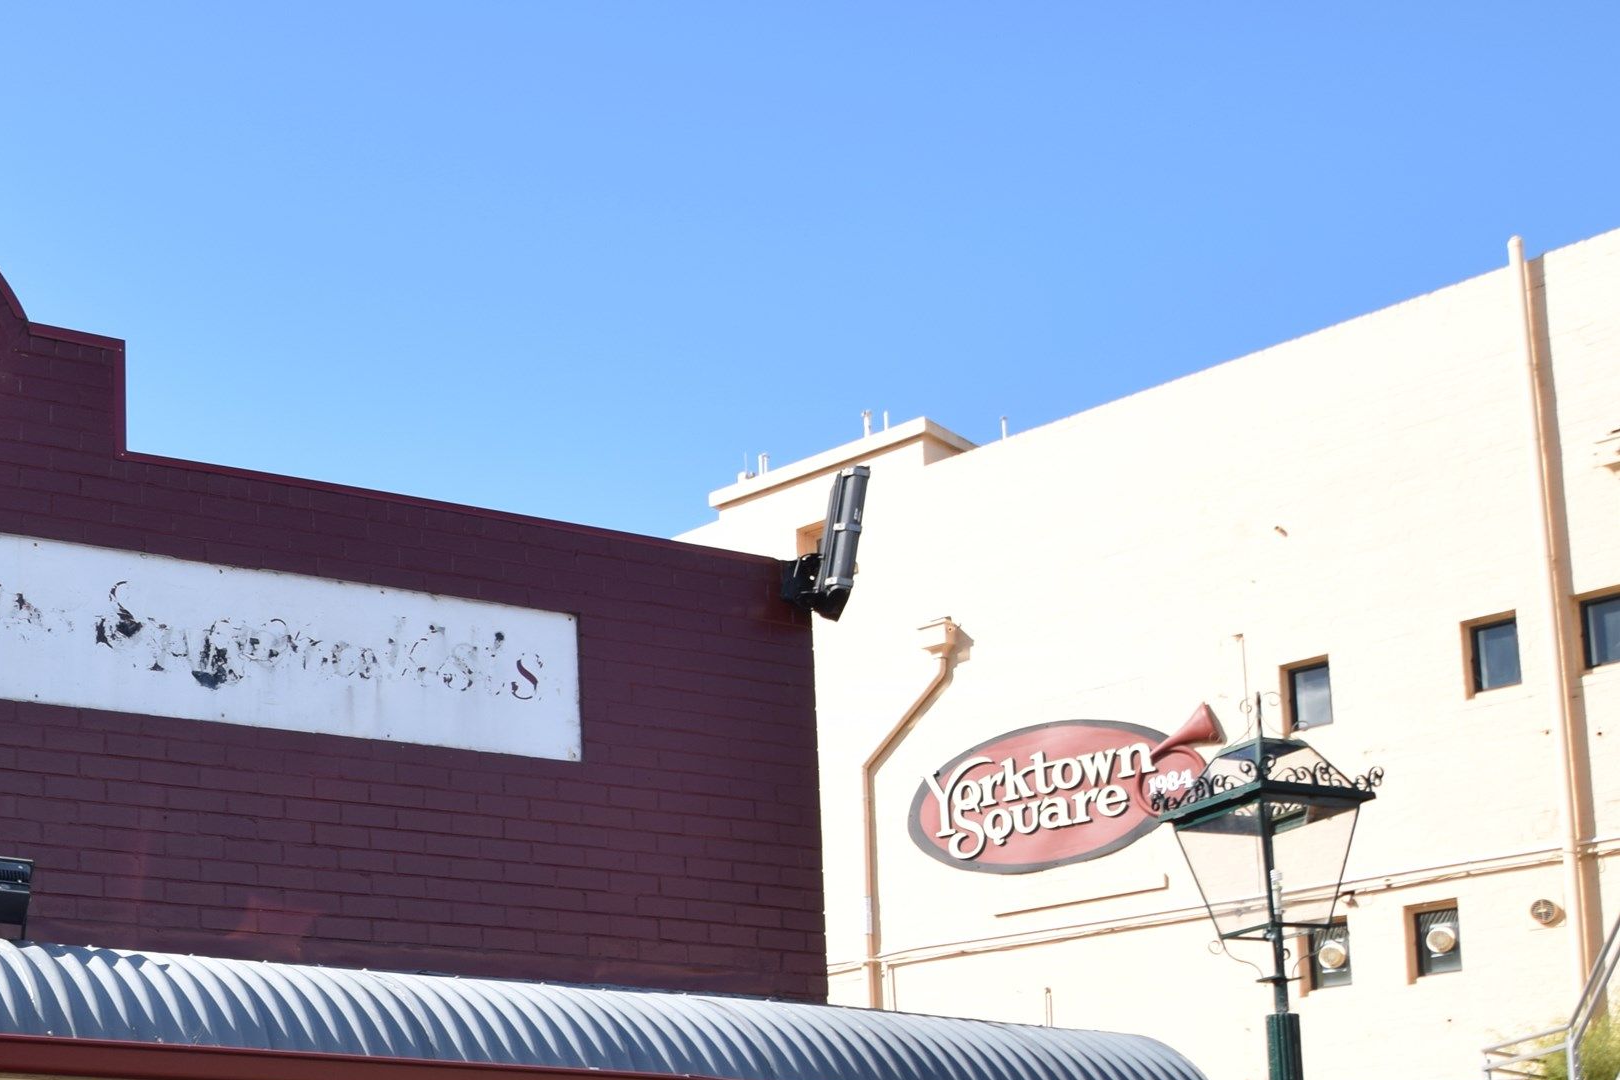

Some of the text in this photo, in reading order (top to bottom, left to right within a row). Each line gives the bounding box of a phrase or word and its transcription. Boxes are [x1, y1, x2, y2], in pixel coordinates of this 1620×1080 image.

[920, 743, 1155, 837] Yorktown
[1147, 768, 1195, 796] 1984
[947, 784, 1130, 860] Square
